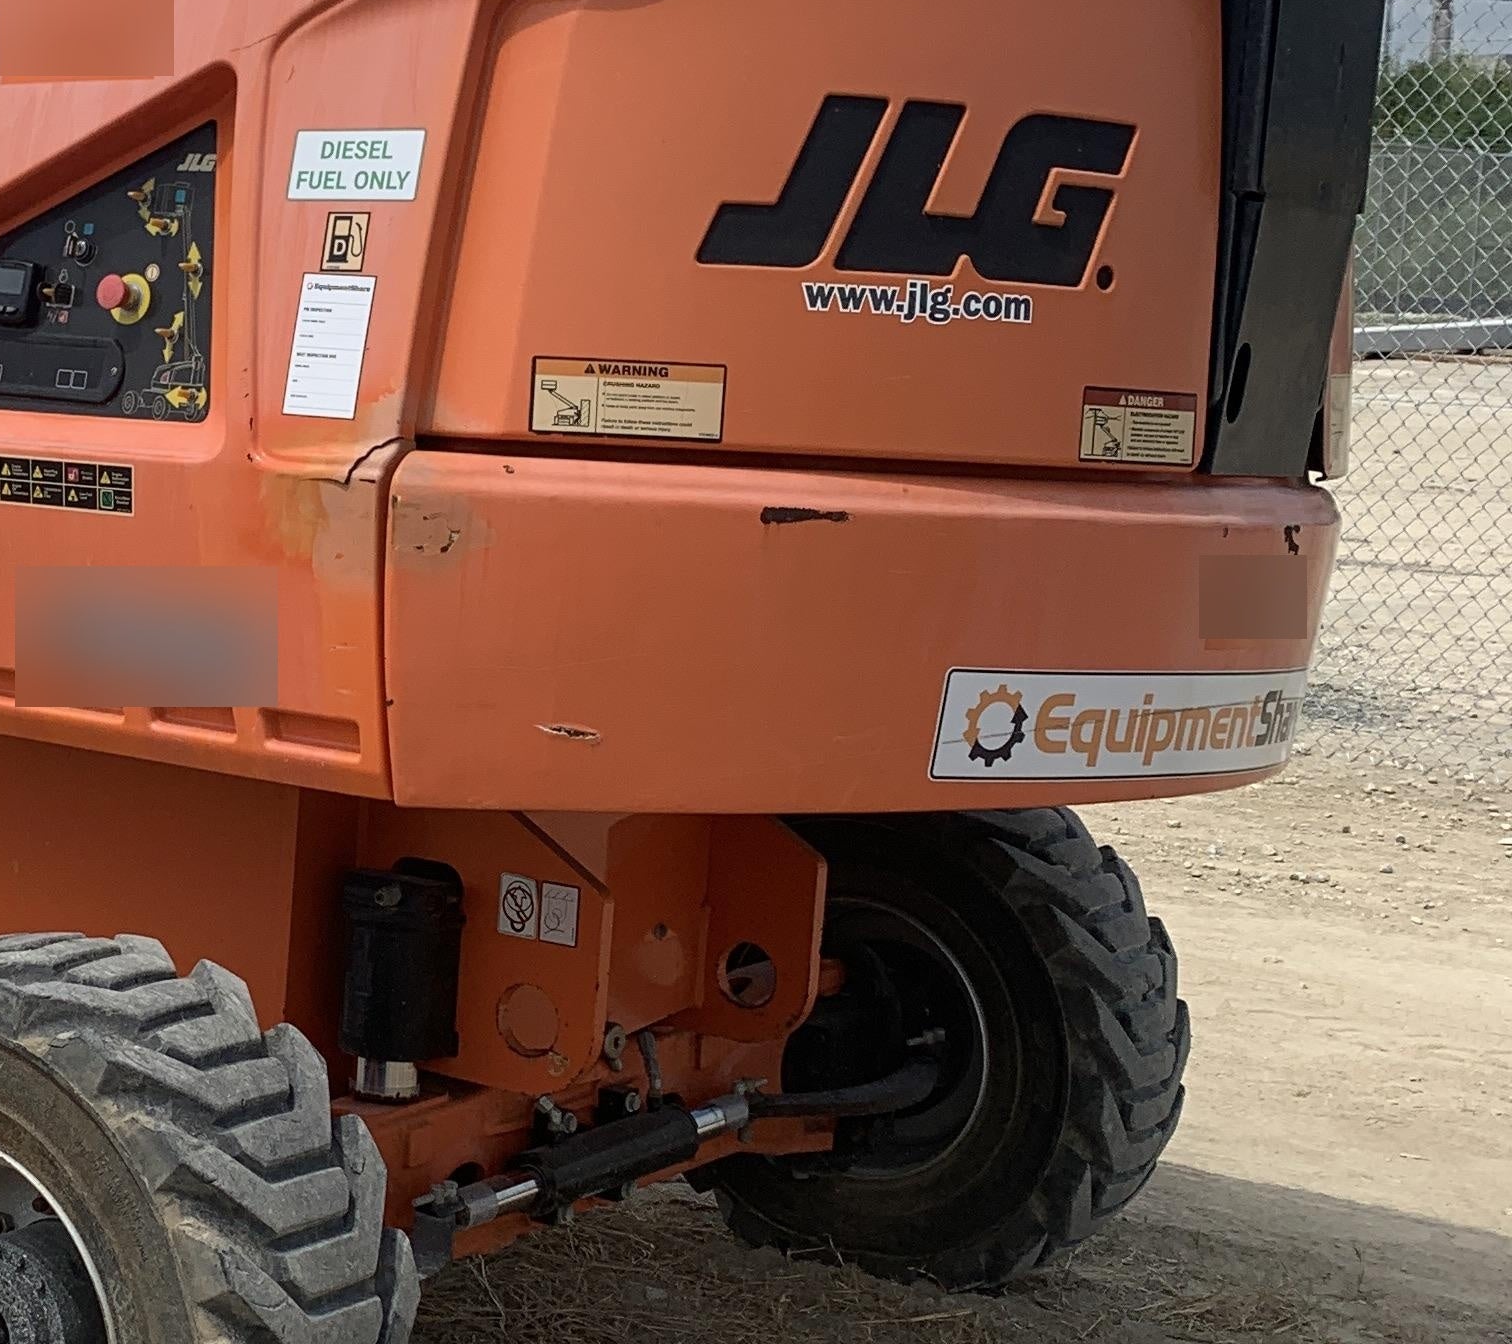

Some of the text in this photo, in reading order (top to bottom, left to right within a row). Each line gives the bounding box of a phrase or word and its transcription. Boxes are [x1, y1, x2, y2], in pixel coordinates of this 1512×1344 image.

[320, 140, 393, 160] DIESEL
[176, 153, 217, 172] JLG
[295, 170, 411, 190] FUEL ONLY
[332, 238, 347, 256] D
[313, 282, 371, 294] EquipmentShare
[801, 279, 1034, 324] www.jlg.com
[598, 363, 669, 378] WARNING
[1127, 395, 1165, 408] DANGER
